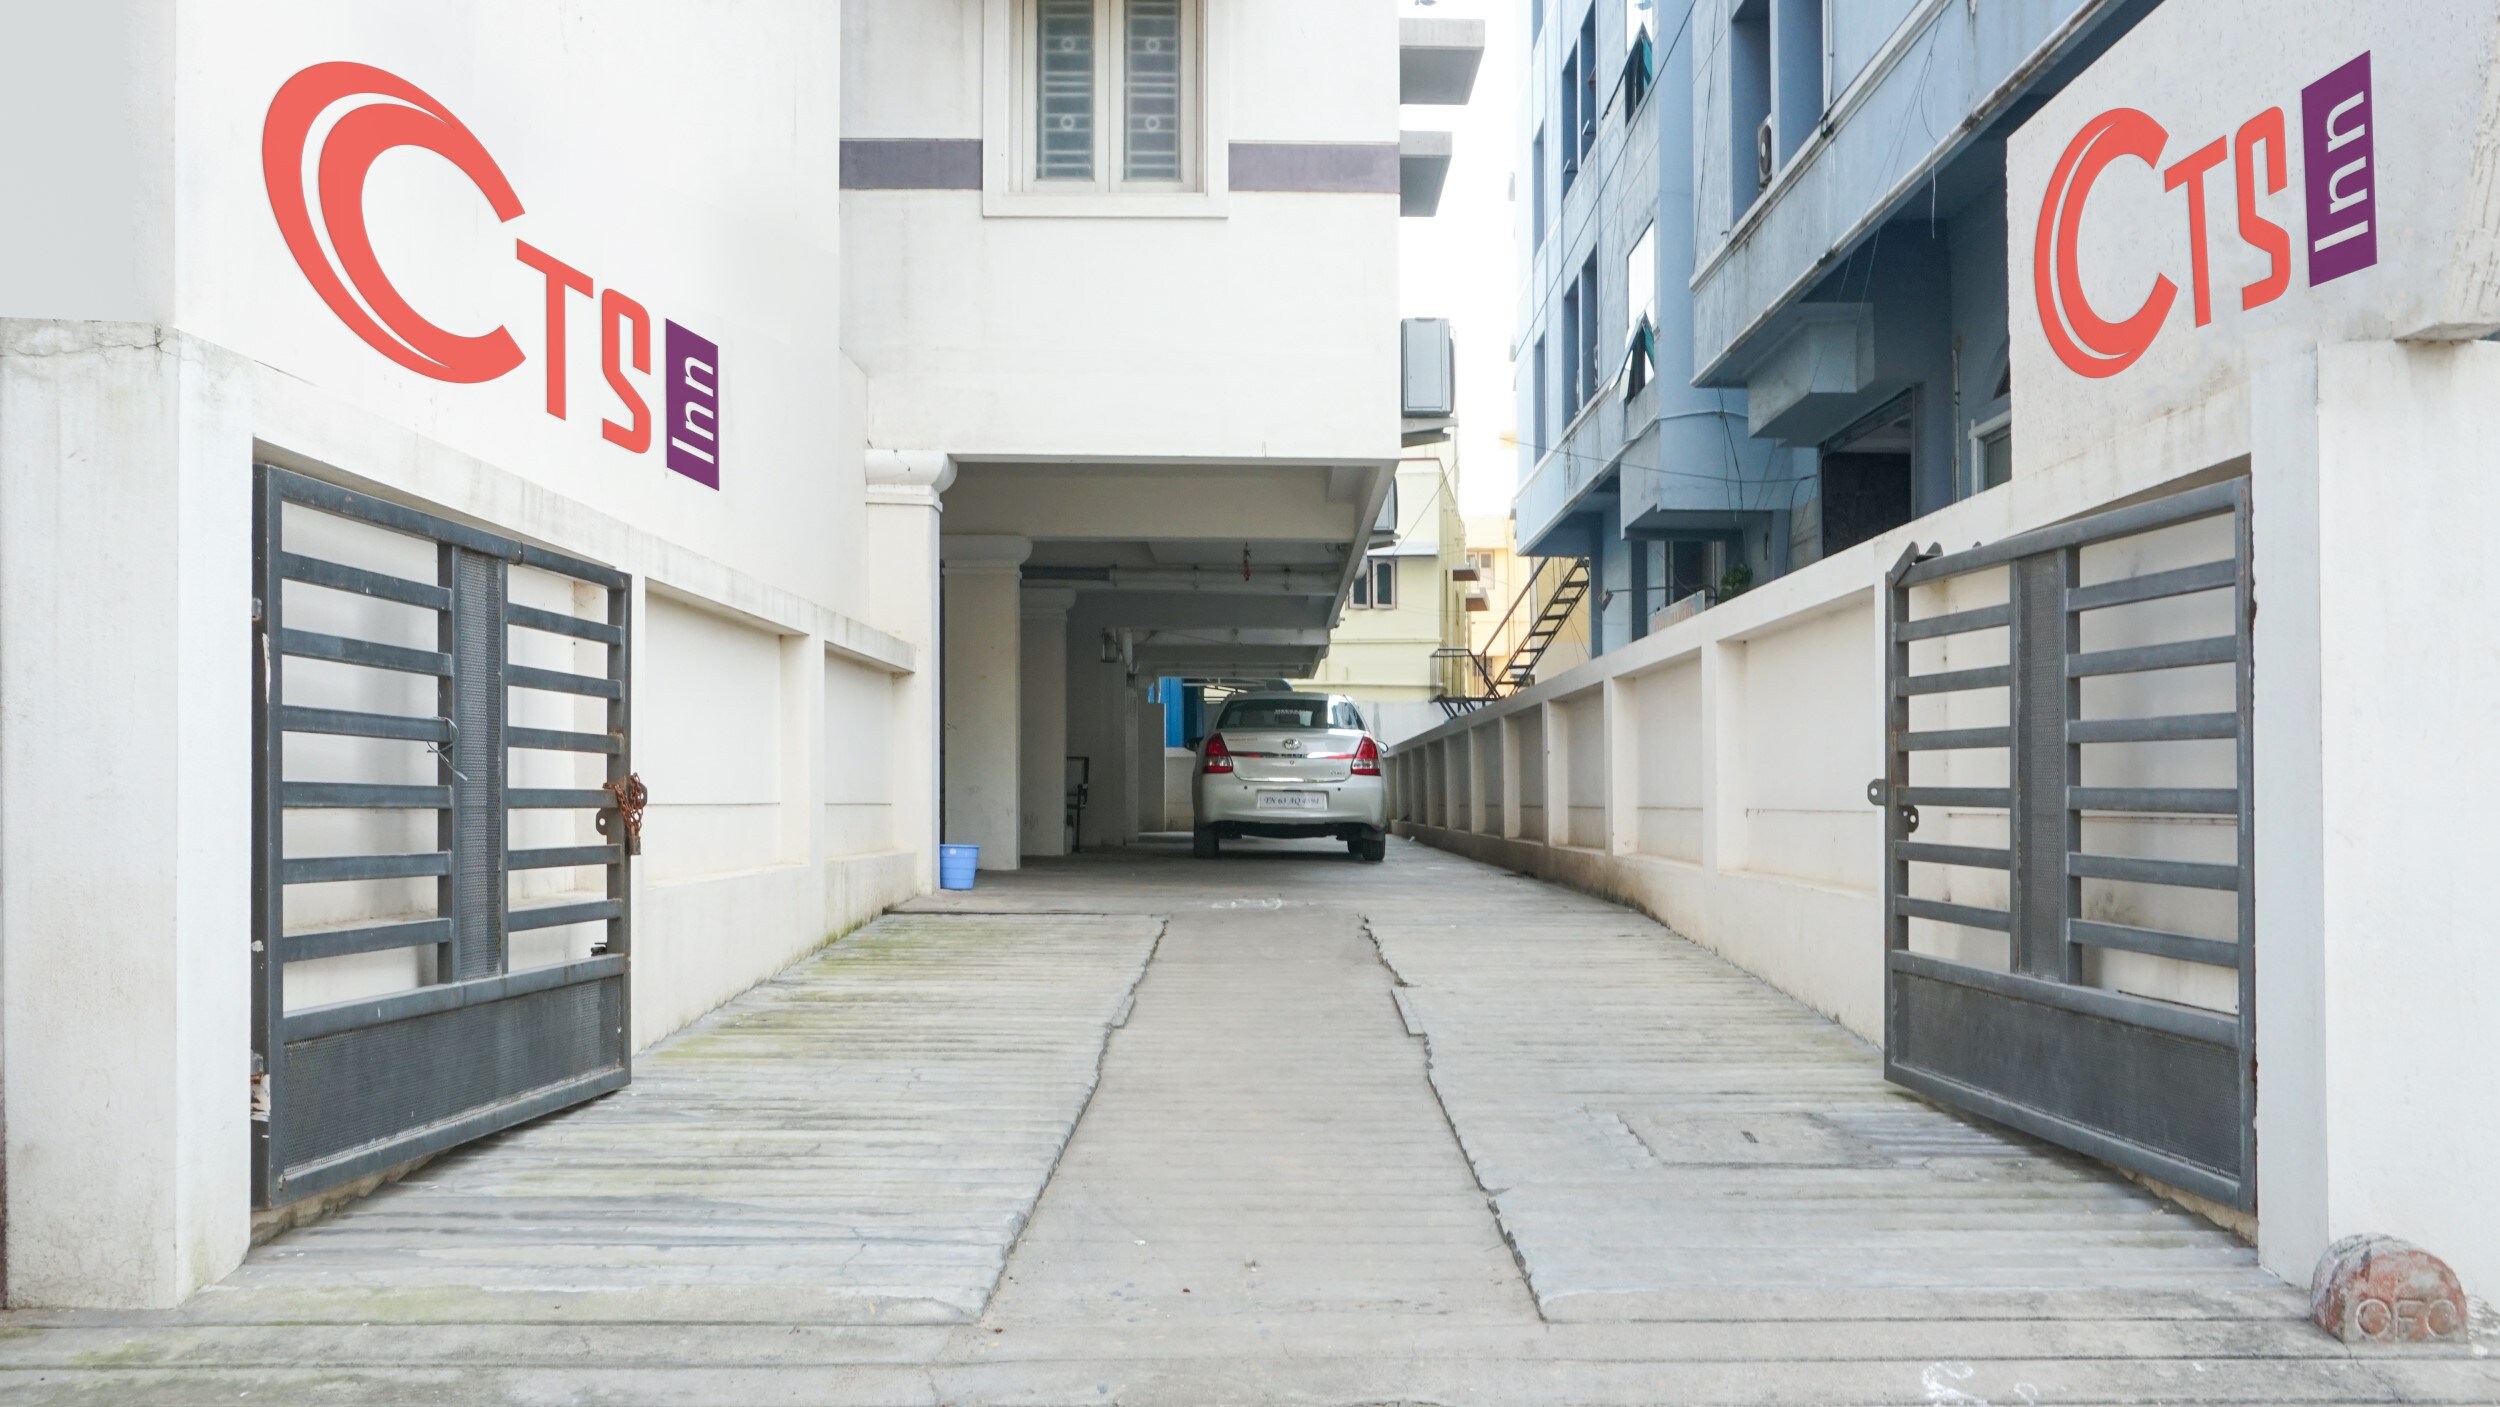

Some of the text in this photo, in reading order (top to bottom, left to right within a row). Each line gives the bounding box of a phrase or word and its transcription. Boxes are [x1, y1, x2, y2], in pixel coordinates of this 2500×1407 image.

[263, 62, 715, 465] CTS Inn
[2034, 90, 2369, 379] CTS Inn
[1264, 796, 1277, 805] TN
